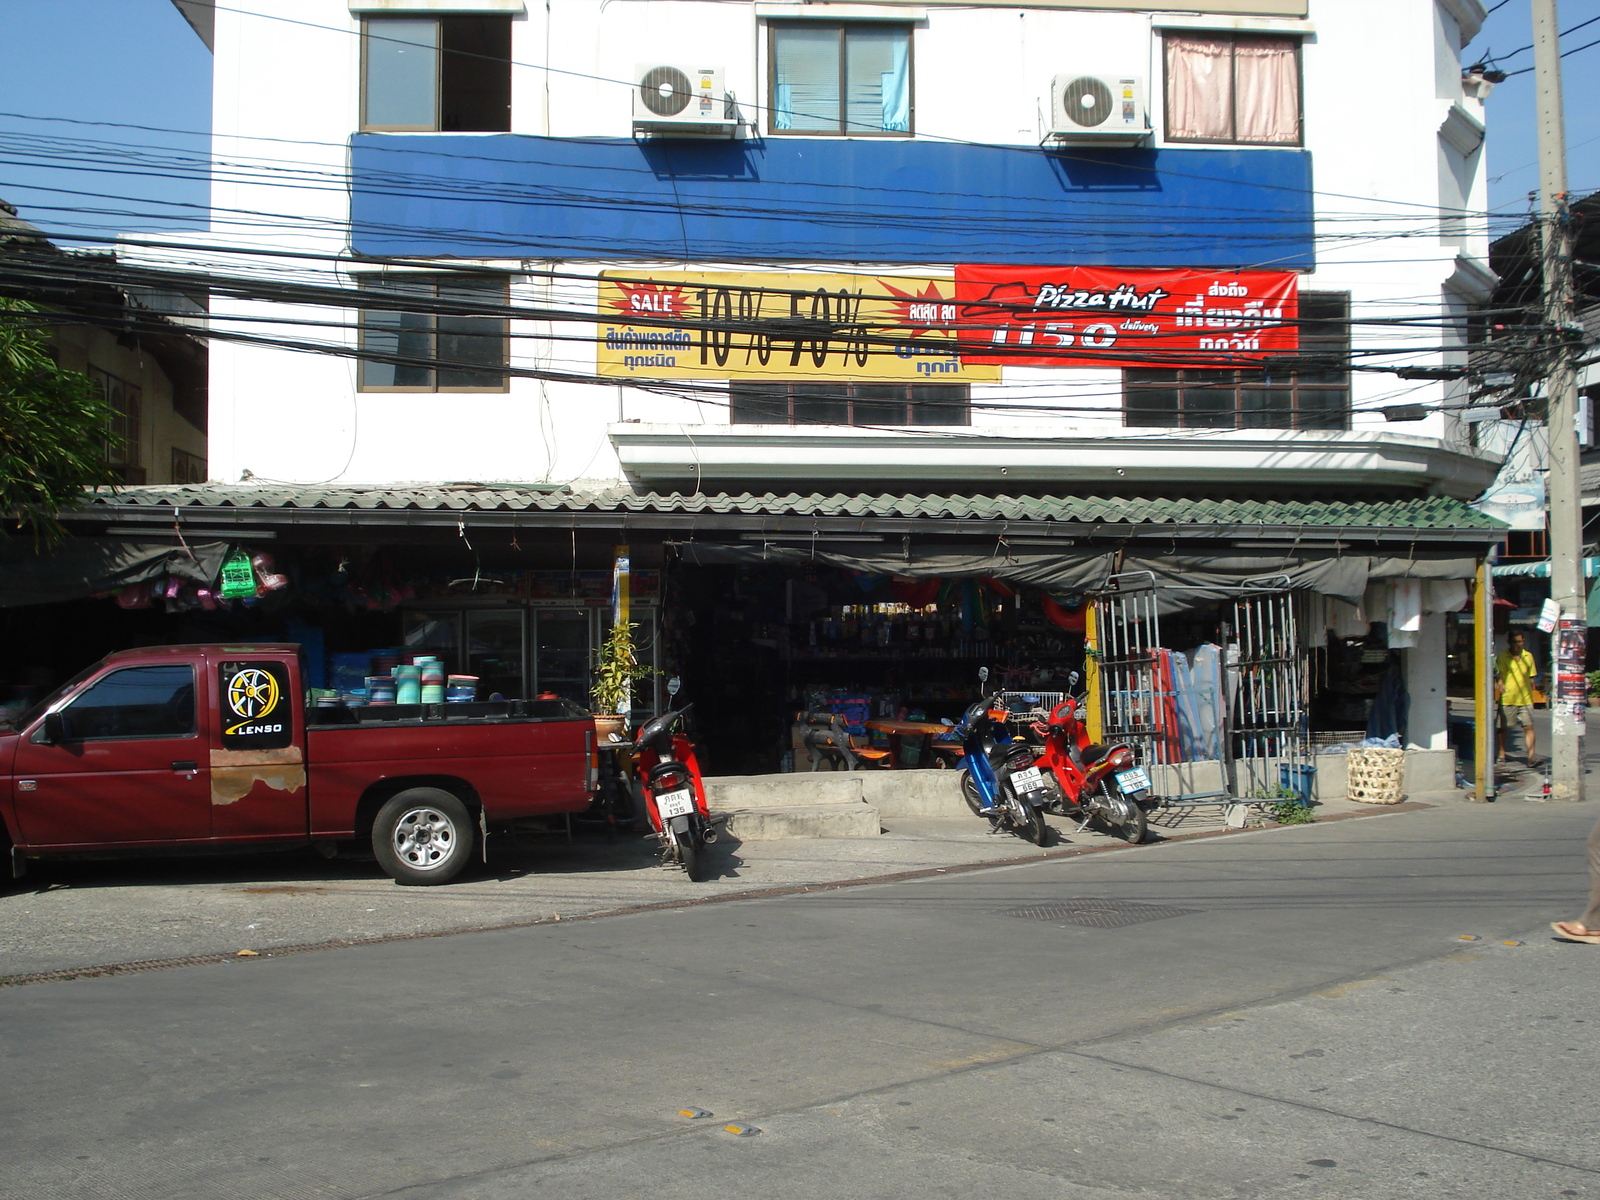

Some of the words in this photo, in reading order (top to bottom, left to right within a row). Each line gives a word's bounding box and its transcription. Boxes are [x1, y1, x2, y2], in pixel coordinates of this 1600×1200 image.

[631, 294, 673, 312] SALE
[1033, 284, 1107, 312] Pizza
[1107, 284, 1169, 311] Hut
[1120, 318, 1159, 334] delivery
[605, 327, 691, 351] สินค้าพลาสติก
[987, 322, 1118, 350] 1150
[1199, 332, 1259, 350] ทกวัน
[623, 353, 676, 371] ทุกชนิด
[238, 724, 282, 735] LENSO
[669, 806, 686, 815] 135
